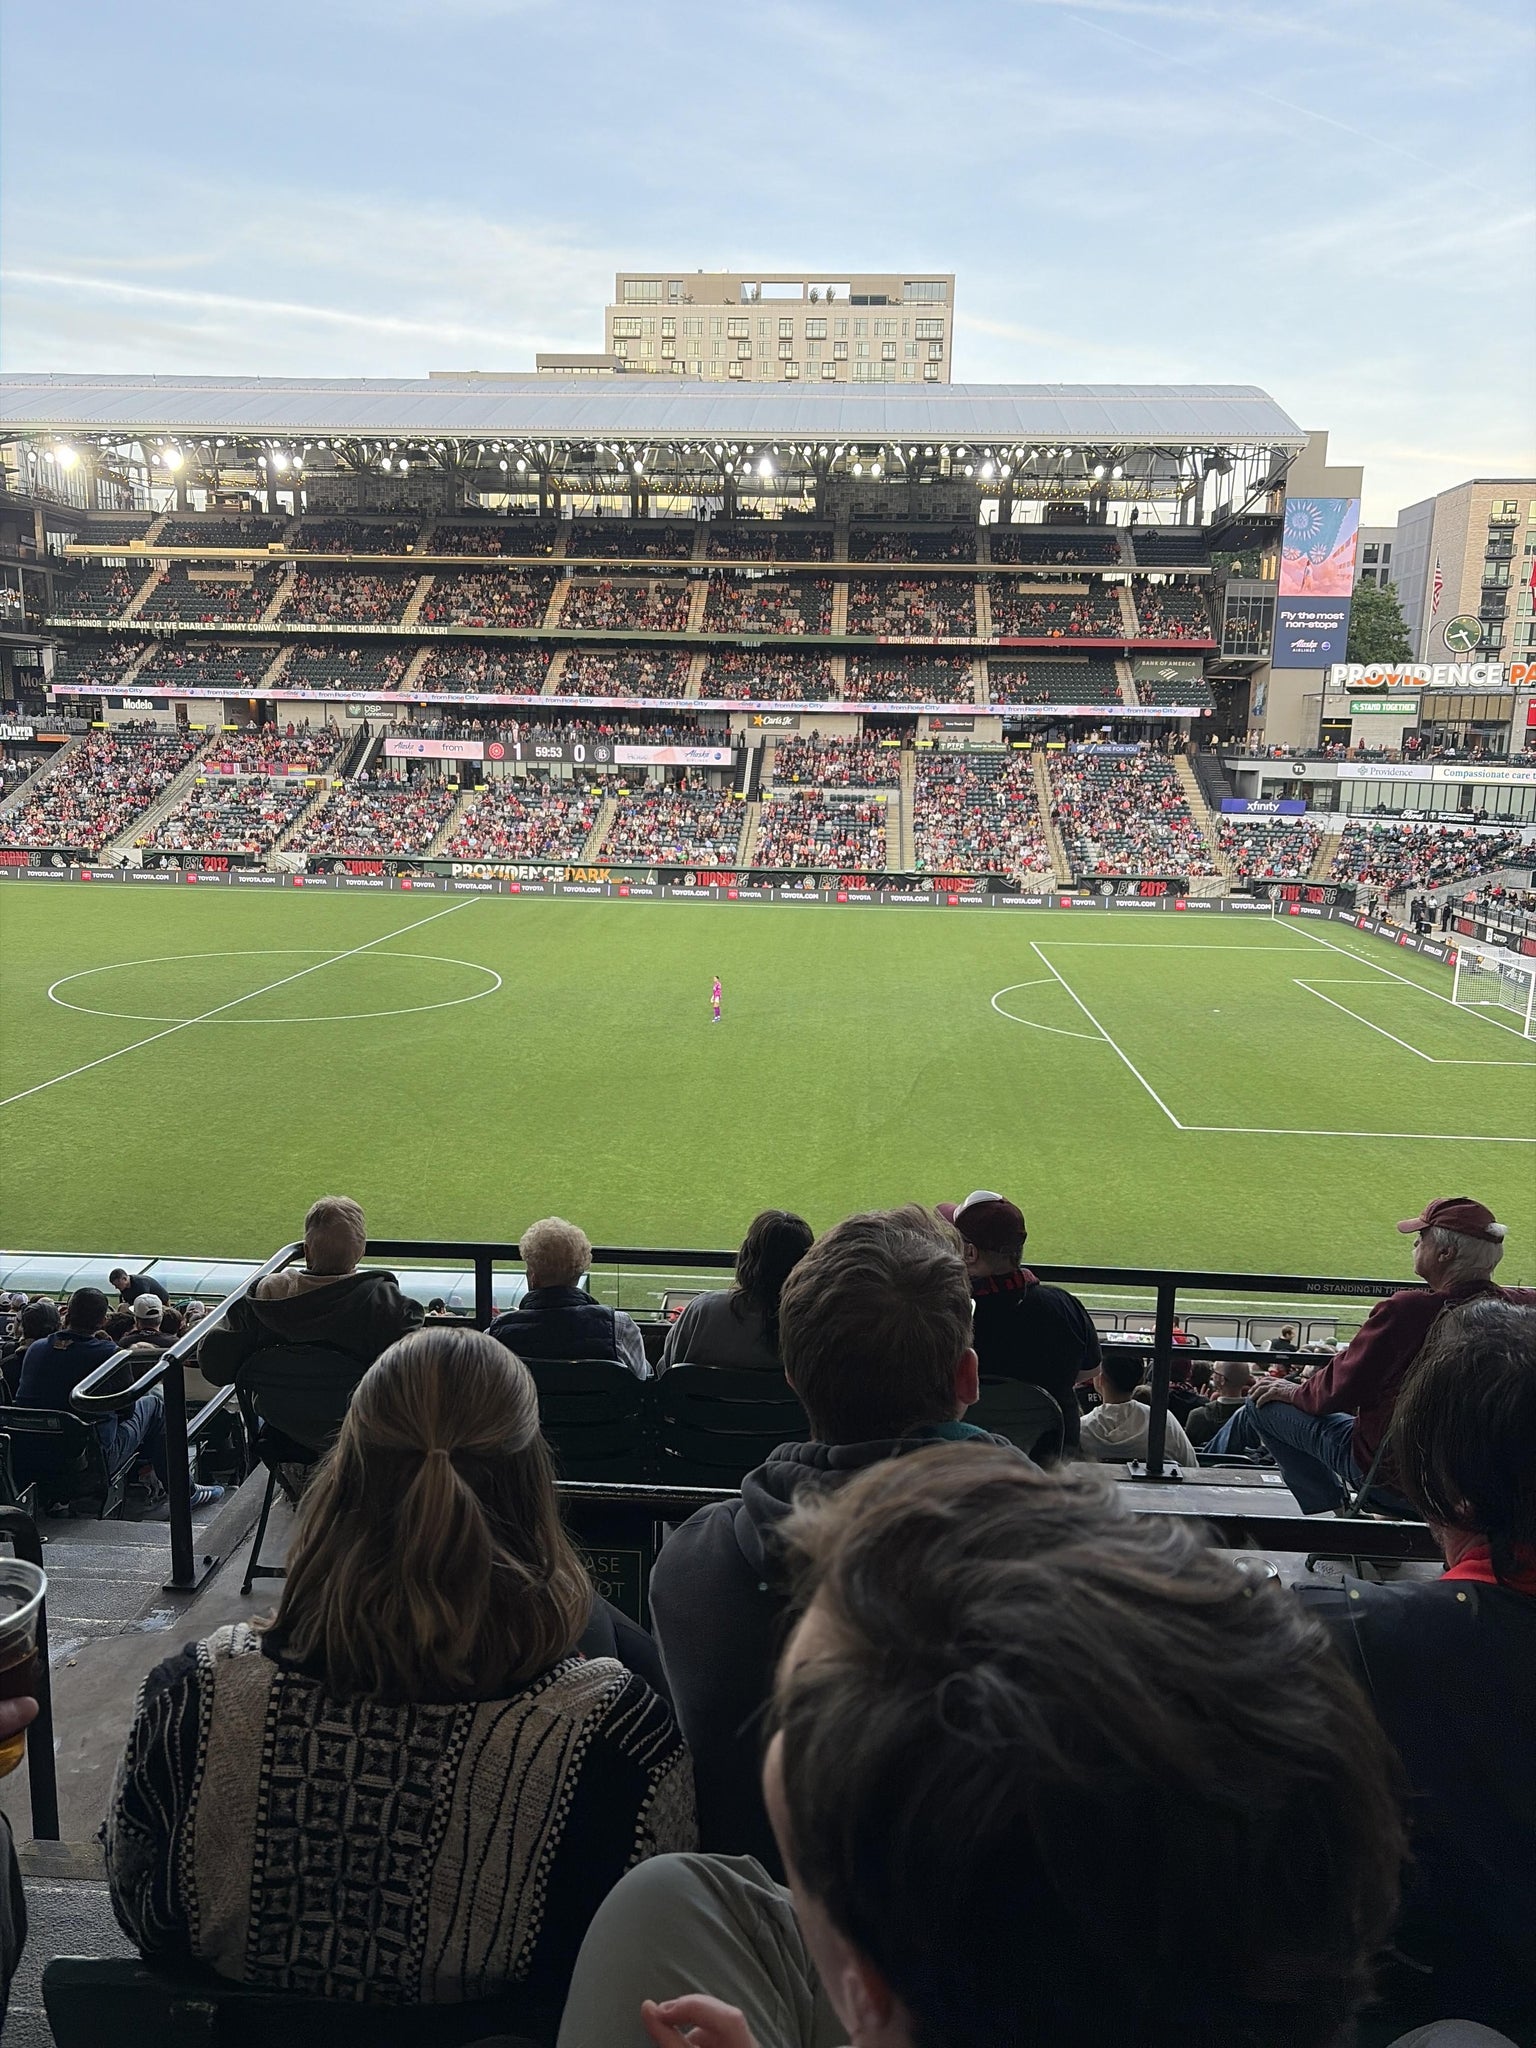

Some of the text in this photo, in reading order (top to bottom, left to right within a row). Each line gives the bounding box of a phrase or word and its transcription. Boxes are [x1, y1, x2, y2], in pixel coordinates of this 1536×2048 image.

[1280, 612, 1296, 620] Fly
[179, 622, 215, 630] CHARLES
[1286, 622, 1338, 630] non-stops
[1331, 662, 1504, 688] PROVIDENCE
[123, 698, 152, 710] Modelo
[1382, 703, 1416, 711] TOGETHER
[513, 743, 522, 760] 1
[535, 747, 562, 757] 59:53
[574, 744, 586, 762] 0
[1370, 767, 1413, 776] Providence
[1443, 769, 1510, 779] Compassionate
[1247, 802, 1279, 813] xfinity
[1401, 810, 1425, 820] Ford
[1323, 1284, 1370, 1293] STANDING
[584, 1556, 620, 1574] ASE
